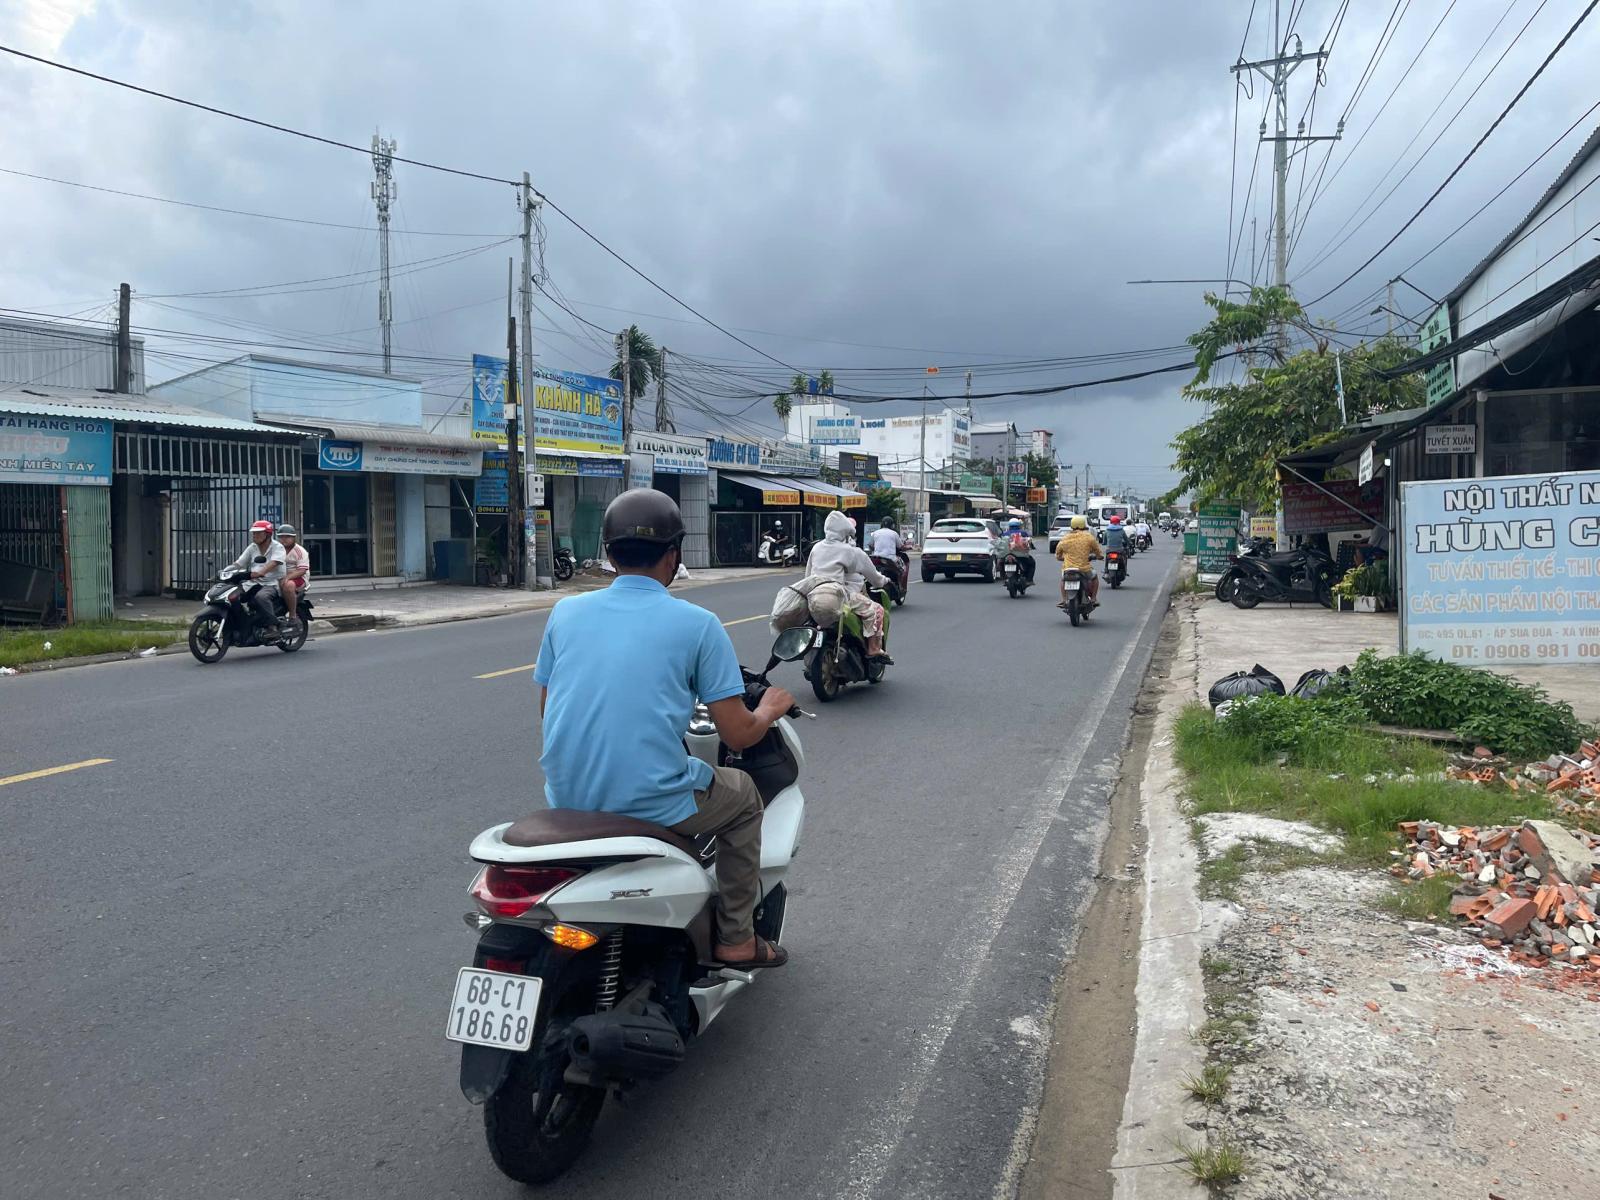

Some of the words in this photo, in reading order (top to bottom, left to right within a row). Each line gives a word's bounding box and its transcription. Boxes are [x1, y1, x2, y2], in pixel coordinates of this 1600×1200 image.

[536, 385, 581, 414] KHÁNH
[585, 390, 602, 417] HÀ
[1427, 434, 1450, 446] TUYẾT
[1452, 434, 1474, 446] XUÂN
[1445, 484, 1495, 514] NỘI
[1501, 477, 1573, 508] THẤT
[1416, 516, 1554, 553] HÙNG
[1452, 554, 1485, 581] VẤN
[1487, 552, 1530, 580] THIẾT
[1534, 551, 1556, 578] KẾ
[1566, 557, 1592, 578] THI
[1411, 590, 1443, 614] CÁC
[1541, 586, 1572, 615] NỘI
[1485, 644, 1531, 659] 0908
[1537, 643, 1569, 659] 981
[467, 975, 526, 1011] 68-C1
[456, 1006, 528, 1044] 186.68
